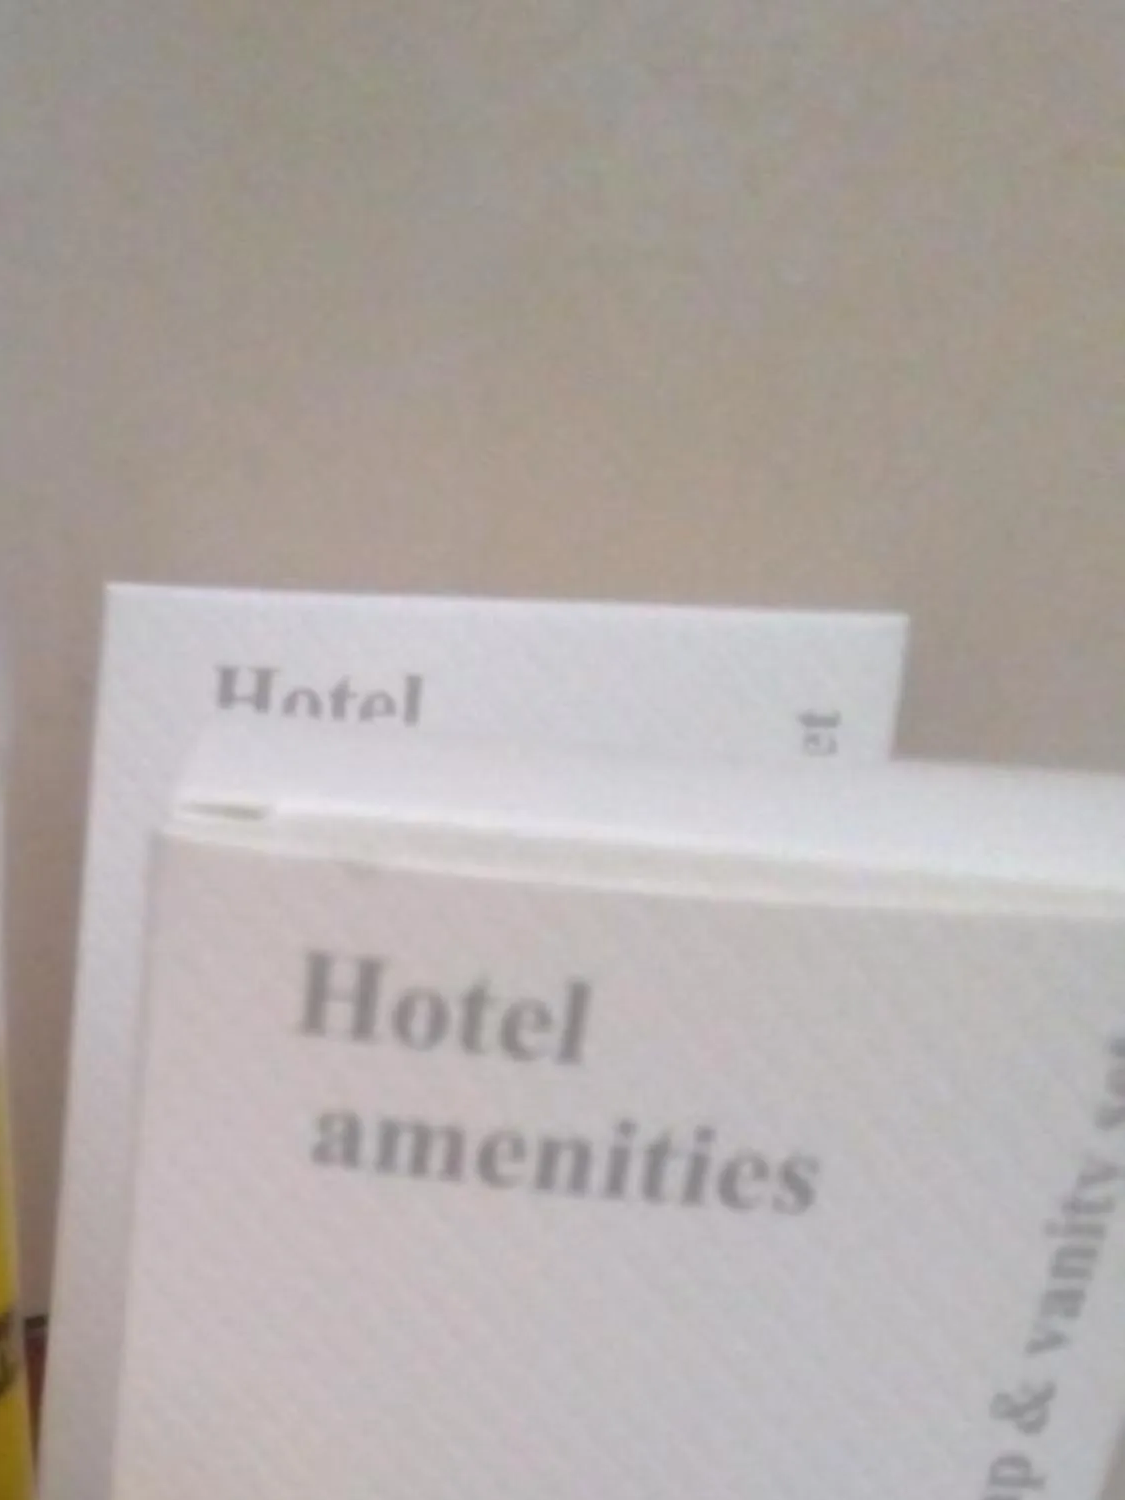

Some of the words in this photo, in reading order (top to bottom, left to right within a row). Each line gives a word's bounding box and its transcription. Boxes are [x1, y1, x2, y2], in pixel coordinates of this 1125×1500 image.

[296, 949, 593, 1066] Hotel
[311, 1104, 821, 1215] amenities
[988, 1380, 1059, 1436] &
[1025, 1153, 1125, 1356] vanity
